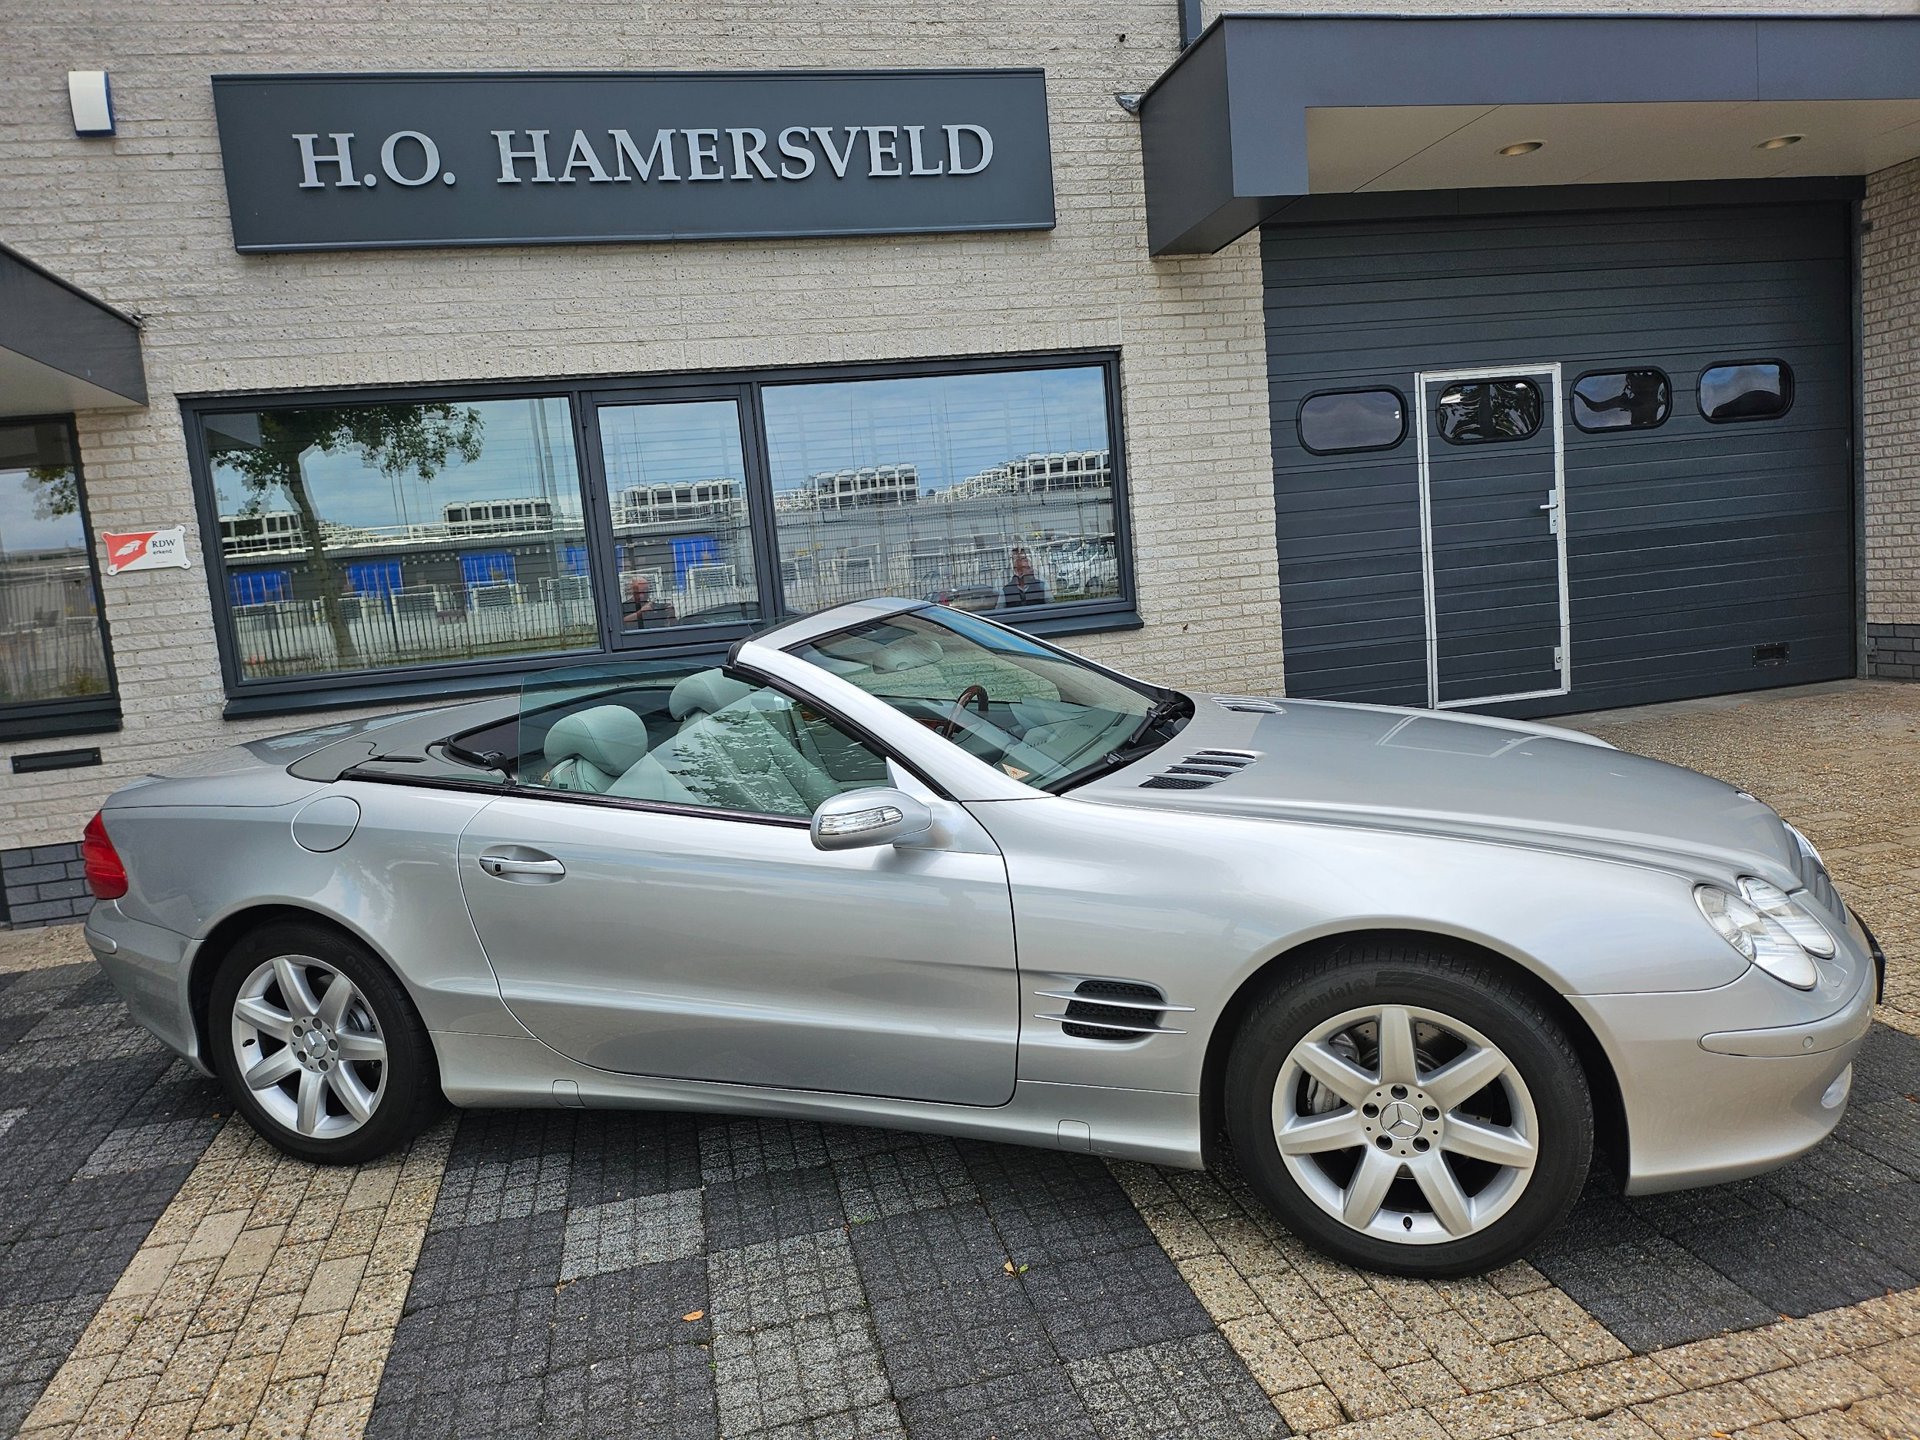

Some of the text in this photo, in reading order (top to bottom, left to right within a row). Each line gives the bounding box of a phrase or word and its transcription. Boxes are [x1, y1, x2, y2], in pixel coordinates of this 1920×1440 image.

[291, 123, 995, 188] H.O. HAMERSVELD
[152, 538, 176, 548] RDW
